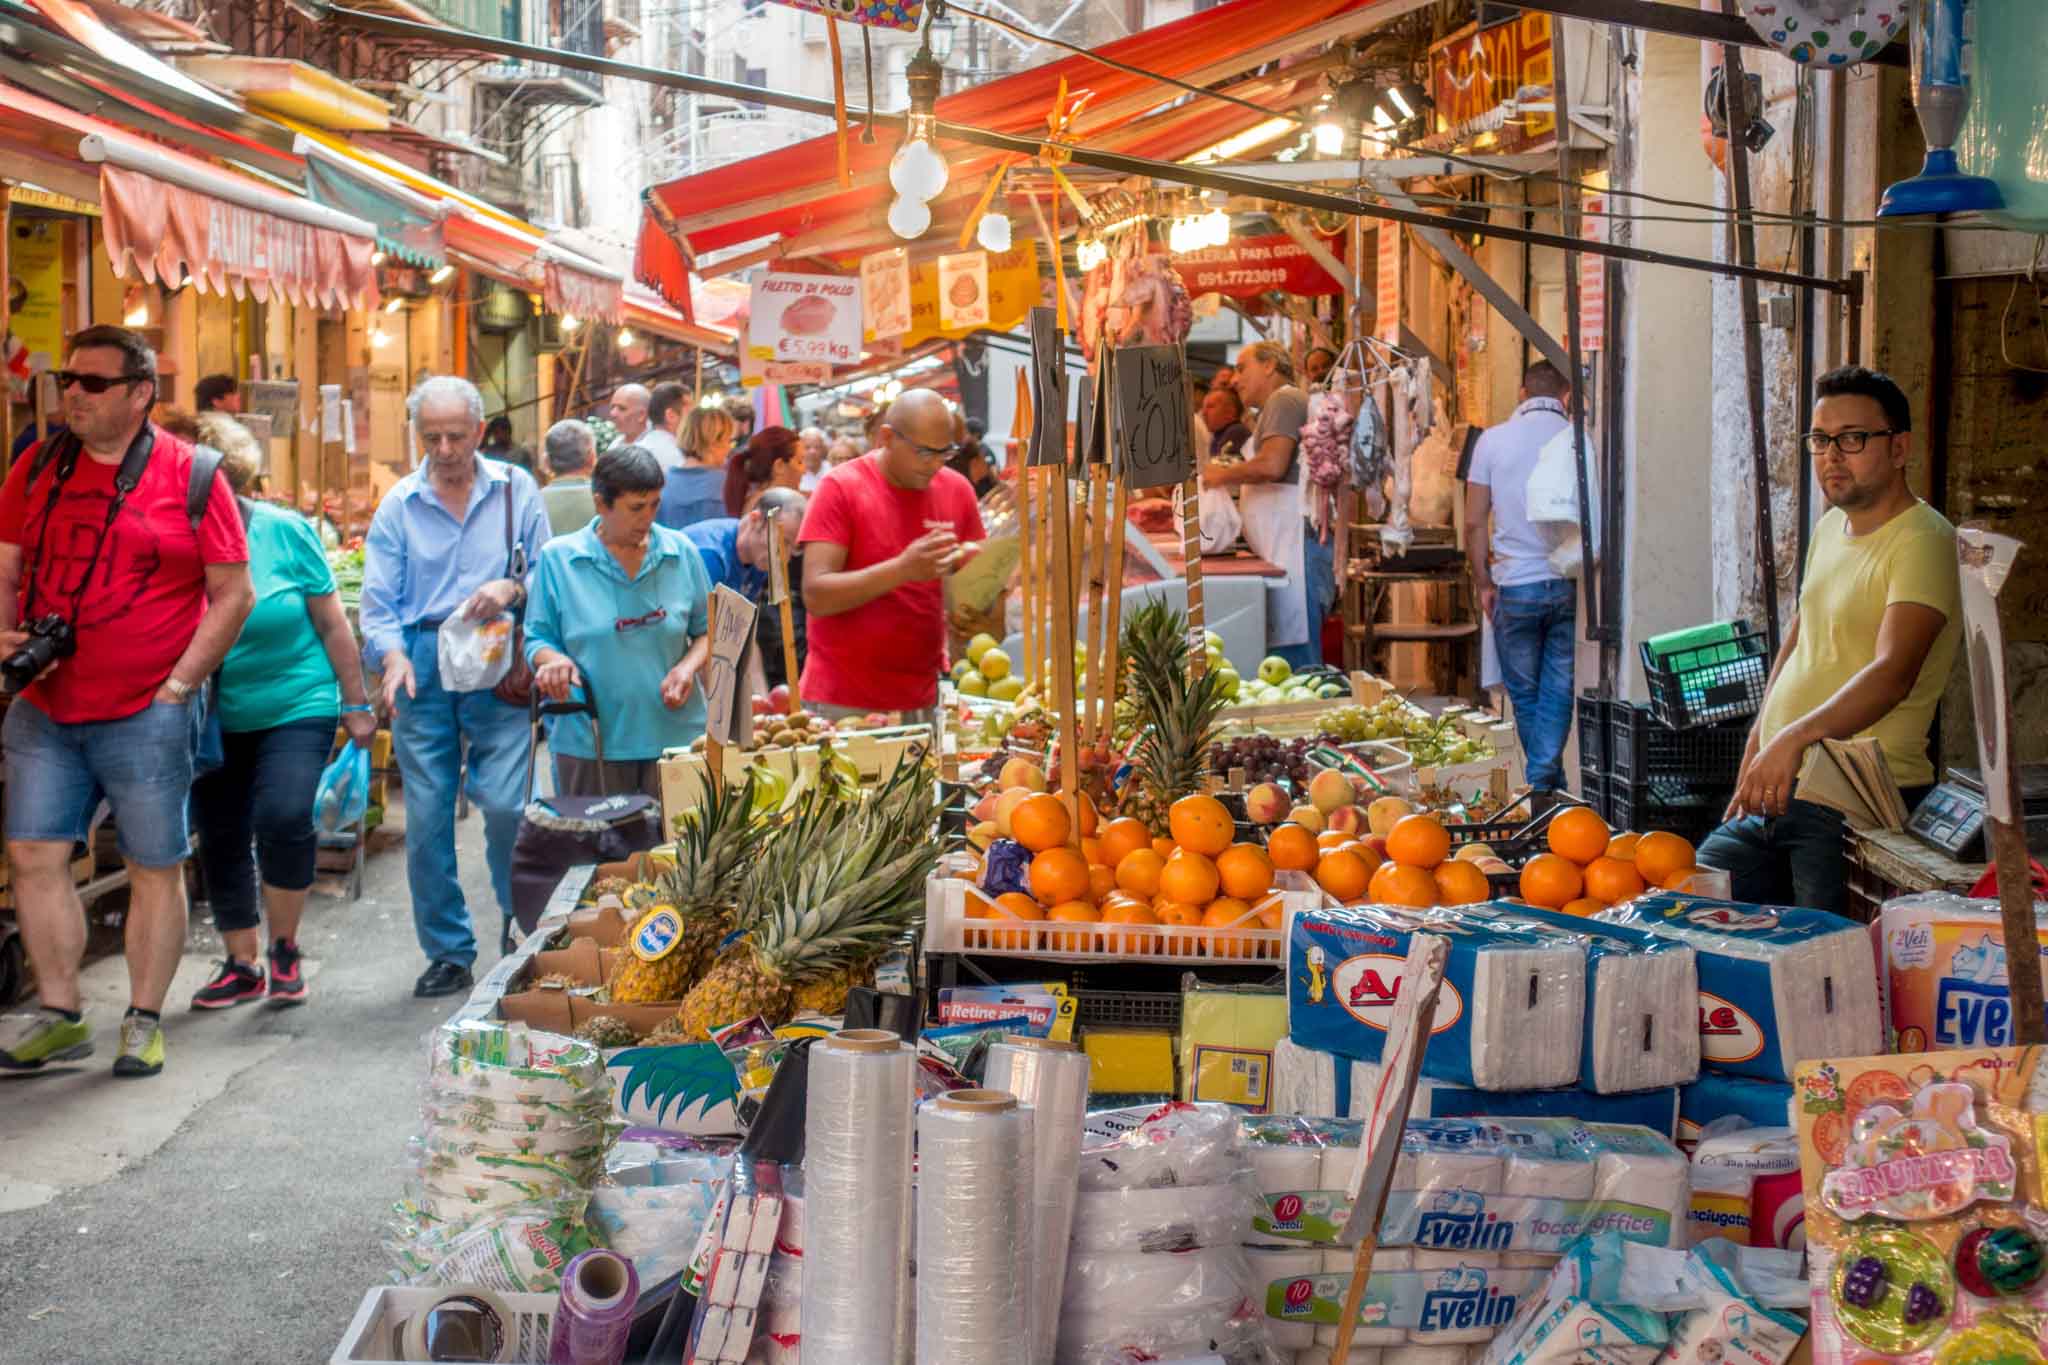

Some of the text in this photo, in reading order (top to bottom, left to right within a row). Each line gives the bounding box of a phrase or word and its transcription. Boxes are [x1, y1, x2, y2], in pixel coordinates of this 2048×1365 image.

[761, 279, 854, 296] FILETTO DI POLLO
[951, 1004, 995, 1018] Retine
[1059, 1000, 1073, 1014] 6
[1281, 1198, 1299, 1216] 10
[1414, 1211, 1516, 1250] Evelin
[524, 1219, 564, 1271] Lucky
[1292, 1283, 1309, 1300] 10
[1284, 1303, 1313, 1314] Rotoli
[1419, 1286, 1517, 1332] Evelin
